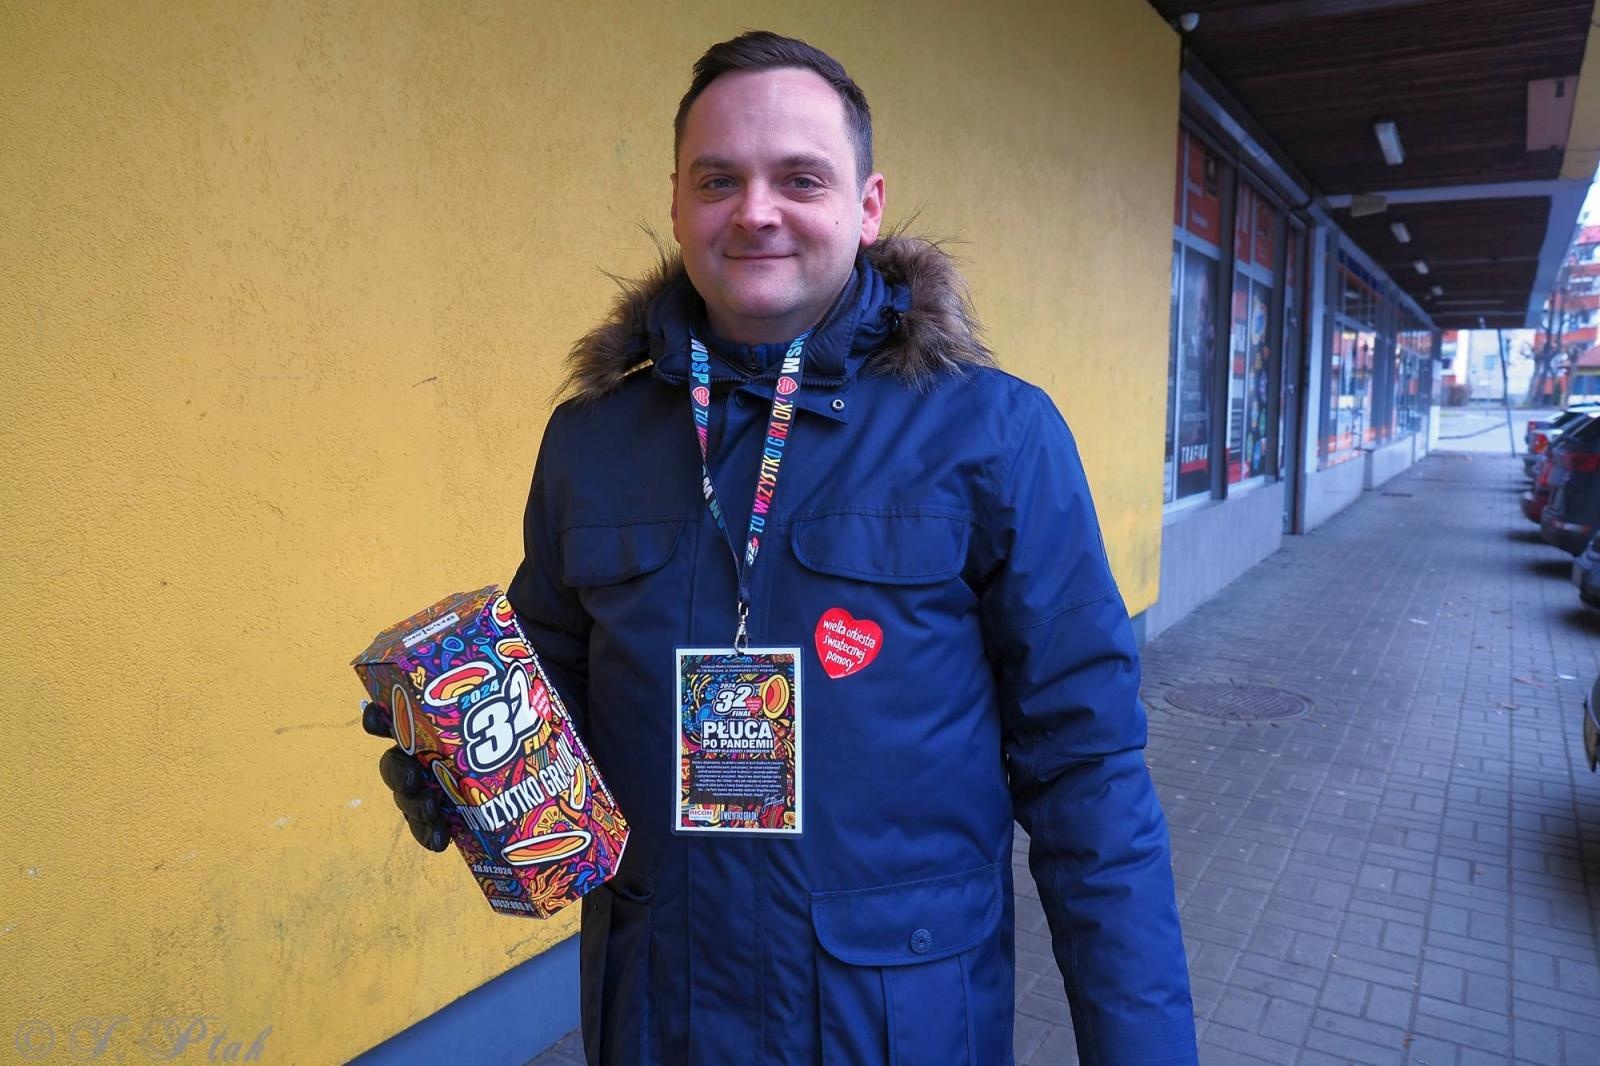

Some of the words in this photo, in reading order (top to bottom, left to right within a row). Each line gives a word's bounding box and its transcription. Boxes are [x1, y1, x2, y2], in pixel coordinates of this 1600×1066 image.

[691, 338, 711, 384] WOŚP
[695, 407, 708, 426] TU
[772, 396, 795, 421] OK!
[766, 421, 789, 447] GRA
[753, 447, 783, 514] WSZYSTKO
[750, 516, 765, 533] TU
[823, 618, 847, 635] wielka
[846, 627, 876, 649] orkiestra
[825, 651, 855, 672] pomocy
[461, 679, 500, 709] 2024
[715, 686, 753, 713] 32
[471, 668, 540, 765] 32
[703, 721, 773, 739] PŁUCA
[702, 739, 718, 748] PO
[720, 739, 774, 749] PANDEMII
[469, 776, 545, 832] WSZYSTKO
